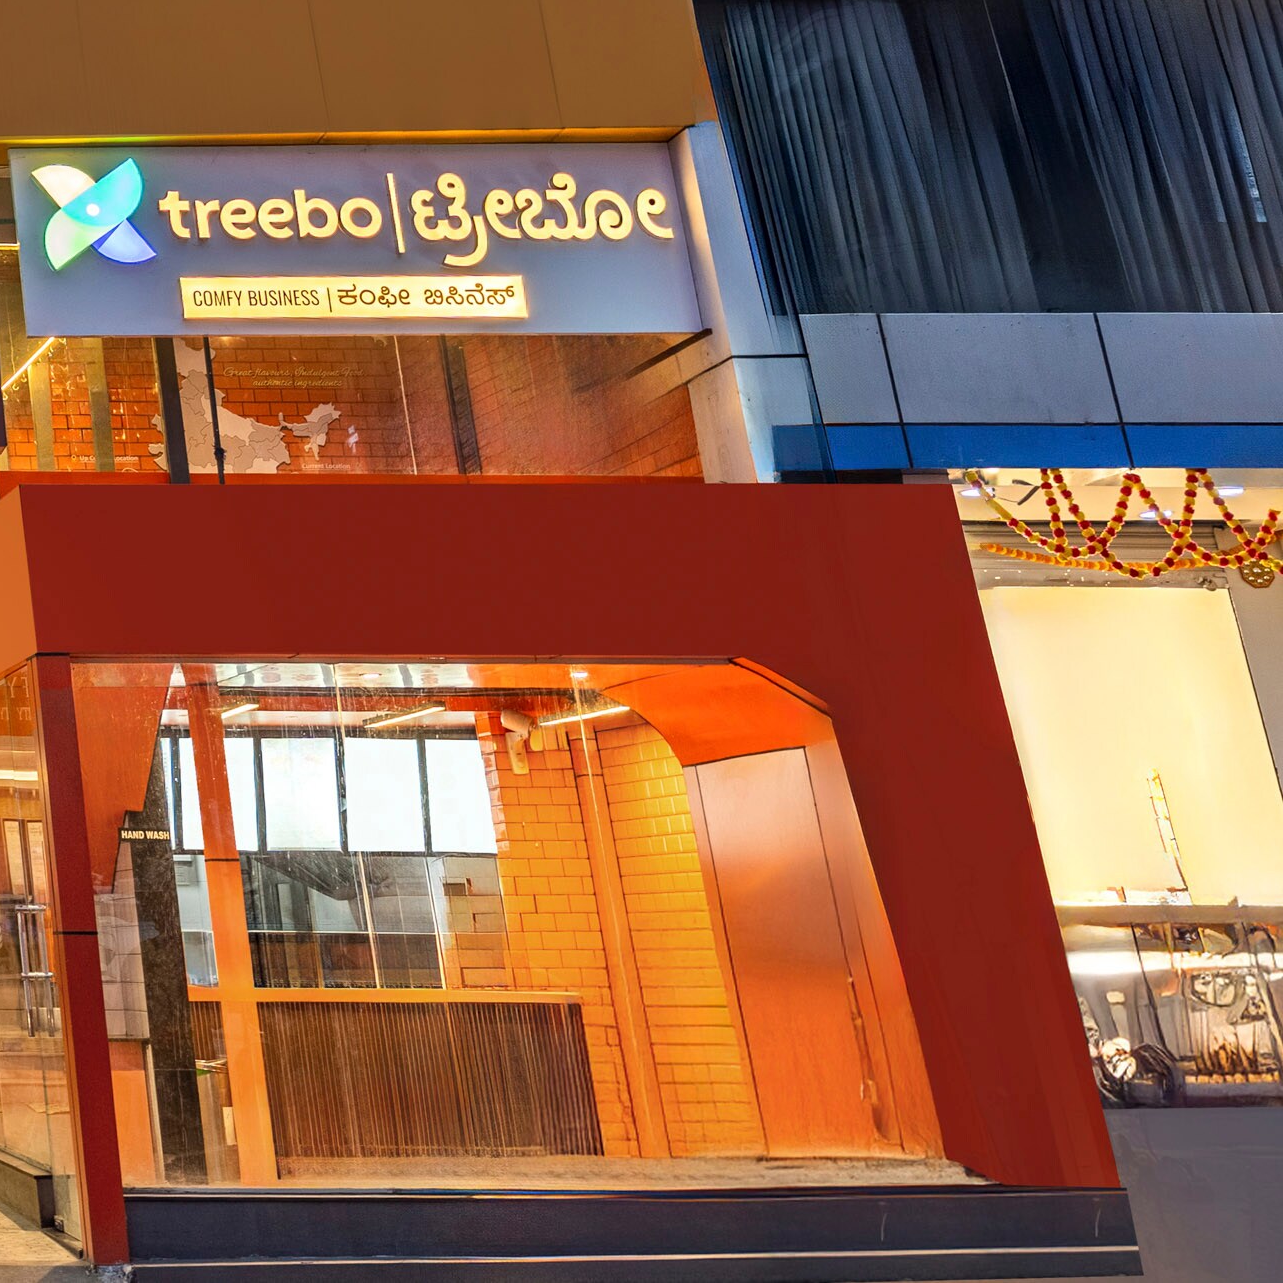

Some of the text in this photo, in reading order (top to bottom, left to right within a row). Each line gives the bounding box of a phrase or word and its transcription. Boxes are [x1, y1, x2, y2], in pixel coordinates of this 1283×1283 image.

[158, 188, 383, 240] treebo
[193, 289, 321, 307] COMFY BUSINESS
[121, 830, 170, 840] HAND WASH
